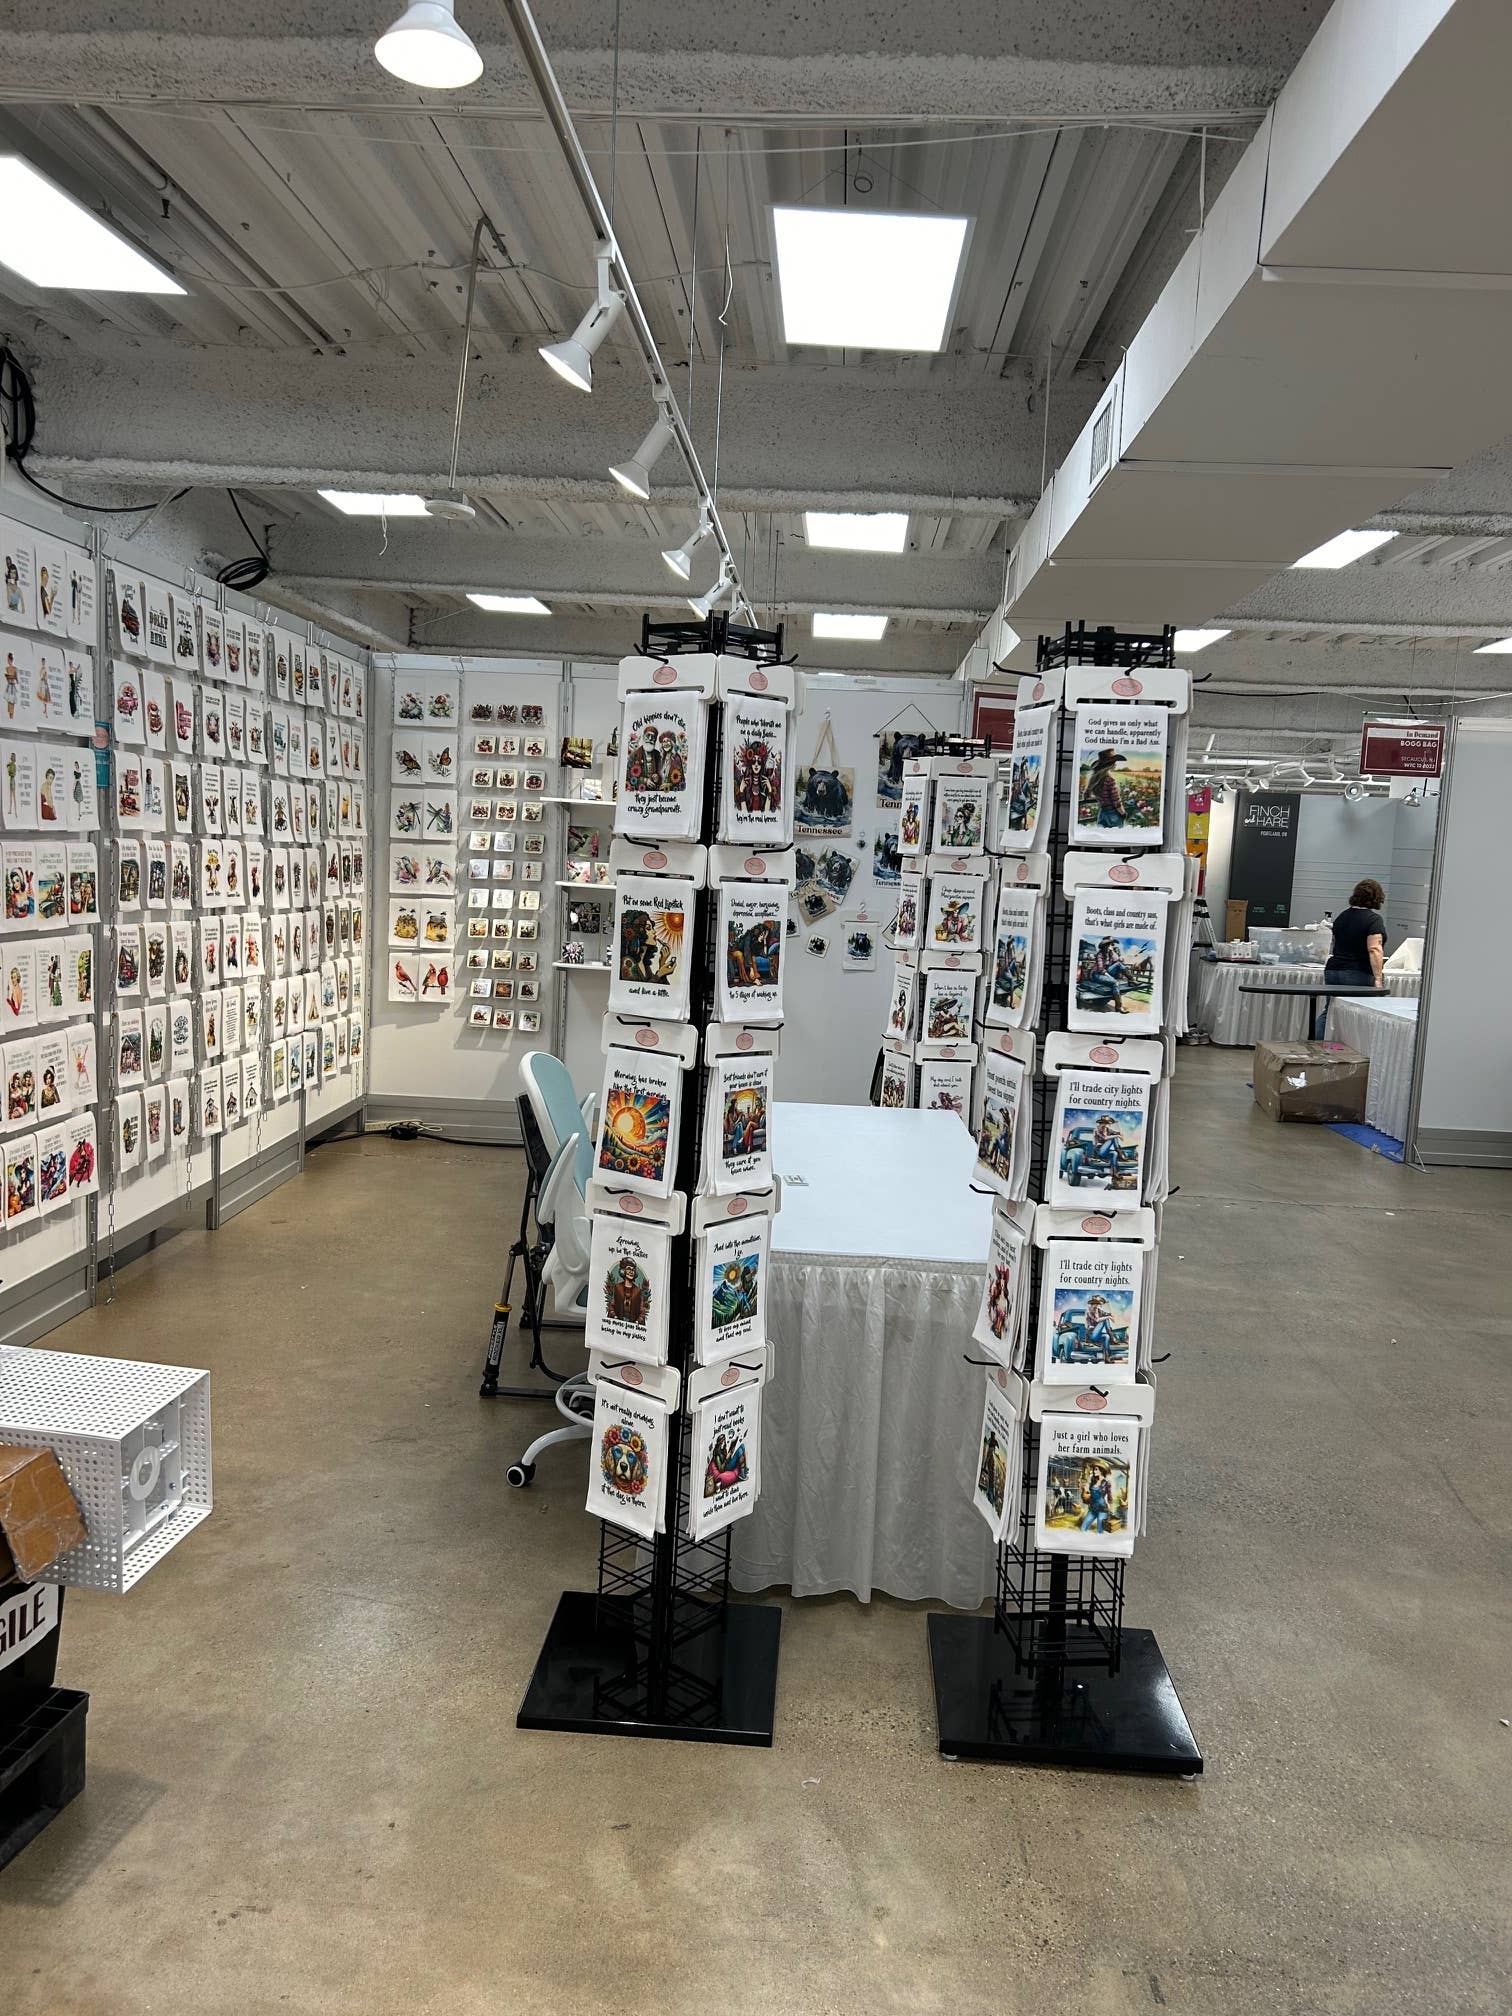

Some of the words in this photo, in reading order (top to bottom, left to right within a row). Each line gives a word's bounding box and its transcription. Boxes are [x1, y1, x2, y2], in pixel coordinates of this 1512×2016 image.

[632, 718, 643, 731] Old
[1102, 719, 1118, 727] gives
[1128, 720, 1142, 729] only
[1130, 730, 1162, 739] apparently
[1414, 730, 1438, 738] Demand
[1250, 805, 1290, 818] FINCH
[1256, 816, 1288, 828] HARE
[796, 825, 842, 834] Tennessee
[623, 894, 633, 906] Put
[654, 896, 664, 909] Red
[1086, 906, 1102, 916] Boots,
[1104, 907, 1114, 916] class
[1126, 911, 1146, 920] country
[1085, 917, 1098, 926] that's
[1100, 919, 1112, 927] what
[1114, 920, 1124, 930] girls
[614, 1069, 637, 1086] Morning
[638, 1075, 648, 1083] has
[648, 1077, 666, 1087] broken
[1070, 1082, 1080, 1092] I'll
[1082, 1084, 1102, 1093] trade
[1104, 1084, 1120, 1097] city
[1121, 1084, 1143, 1096] lights
[1069, 1094, 1081, 1104] for
[1084, 1098, 1113, 1108] country
[1115, 1097, 1141, 1108] nights.
[1060, 1260, 1070, 1270] I'll
[1072, 1260, 1091, 1270] trade
[1094, 1262, 1108, 1274] city
[1111, 1261, 1132, 1273] lights
[1060, 1273, 1072, 1283] for
[1074, 1276, 1102, 1287] country
[1105, 1275, 1130, 1287] nights.
[601, 1324, 615, 1335] being
[600, 1398, 609, 1408] It's
[618, 1408, 632, 1418] really
[633, 1411, 655, 1430] drinking
[1053, 1430, 1068, 1440] Just
[1077, 1432, 1090, 1442] girl
[1093, 1432, 1108, 1442] who
[1110, 1432, 1128, 1442] loves
[1058, 1443, 1070, 1452] her
[1072, 1444, 1090, 1454] farm
[616, 1490, 626, 1505] dog
